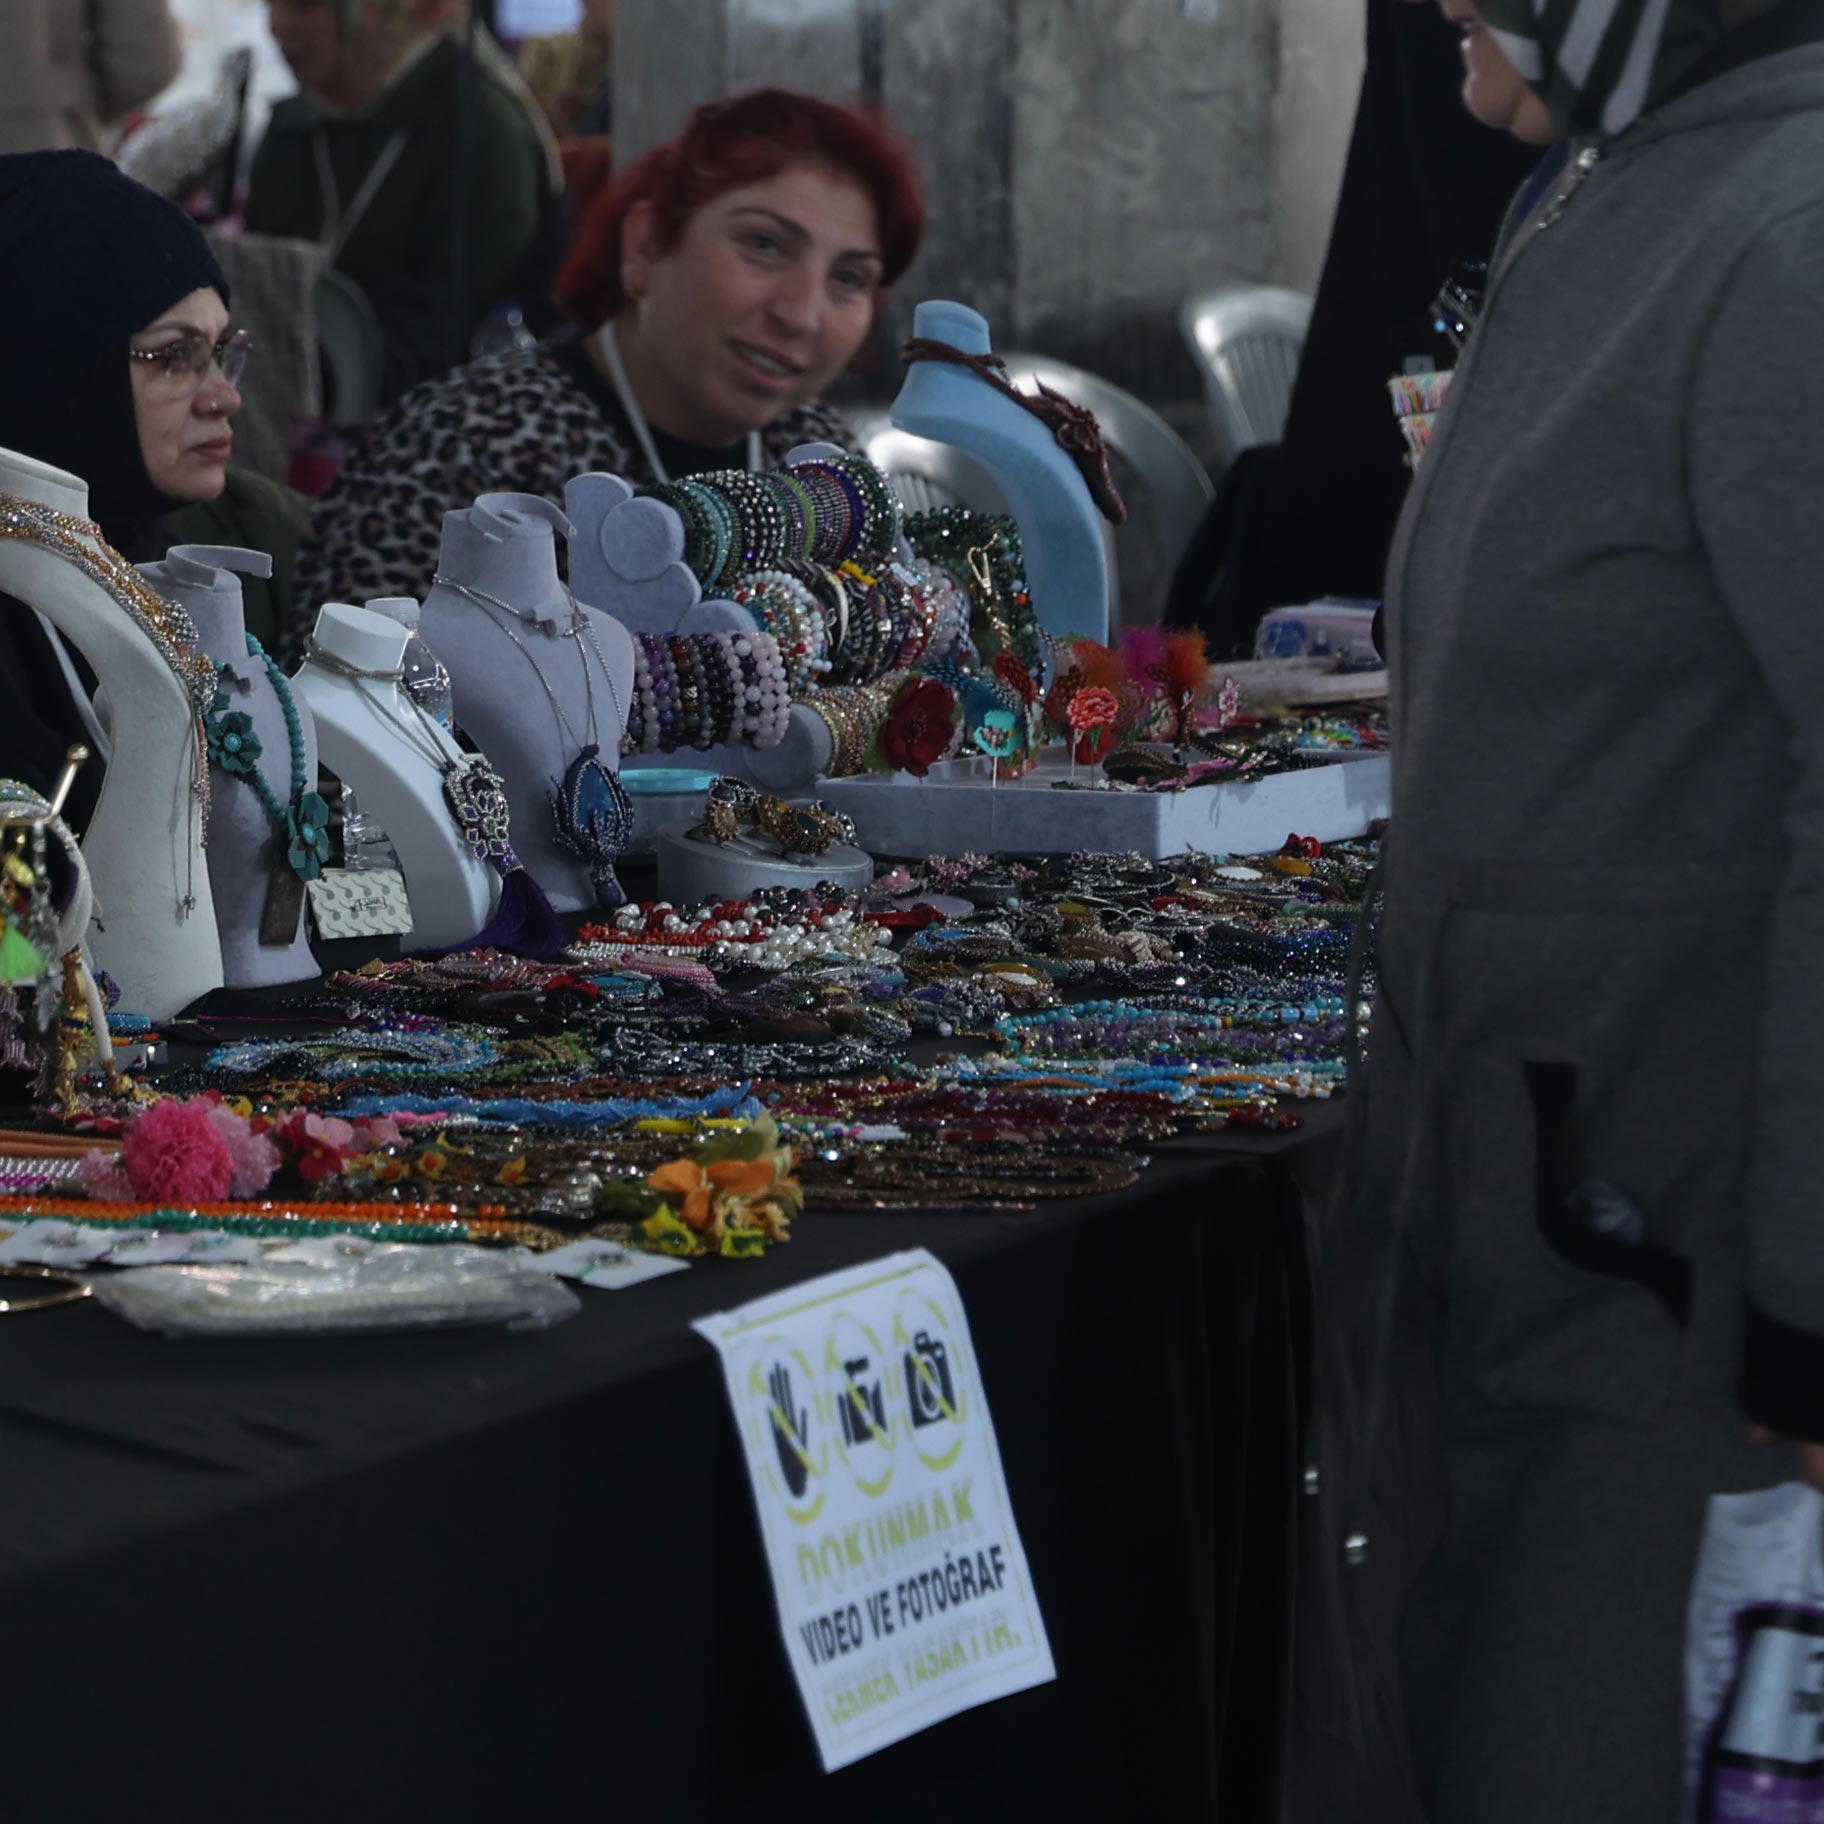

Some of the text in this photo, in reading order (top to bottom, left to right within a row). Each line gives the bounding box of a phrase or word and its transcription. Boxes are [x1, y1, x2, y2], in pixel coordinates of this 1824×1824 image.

[796, 1476, 980, 1600] DOKUNMAK
[800, 1543, 1006, 1666] VIDEO VE FOTOĞRAF
